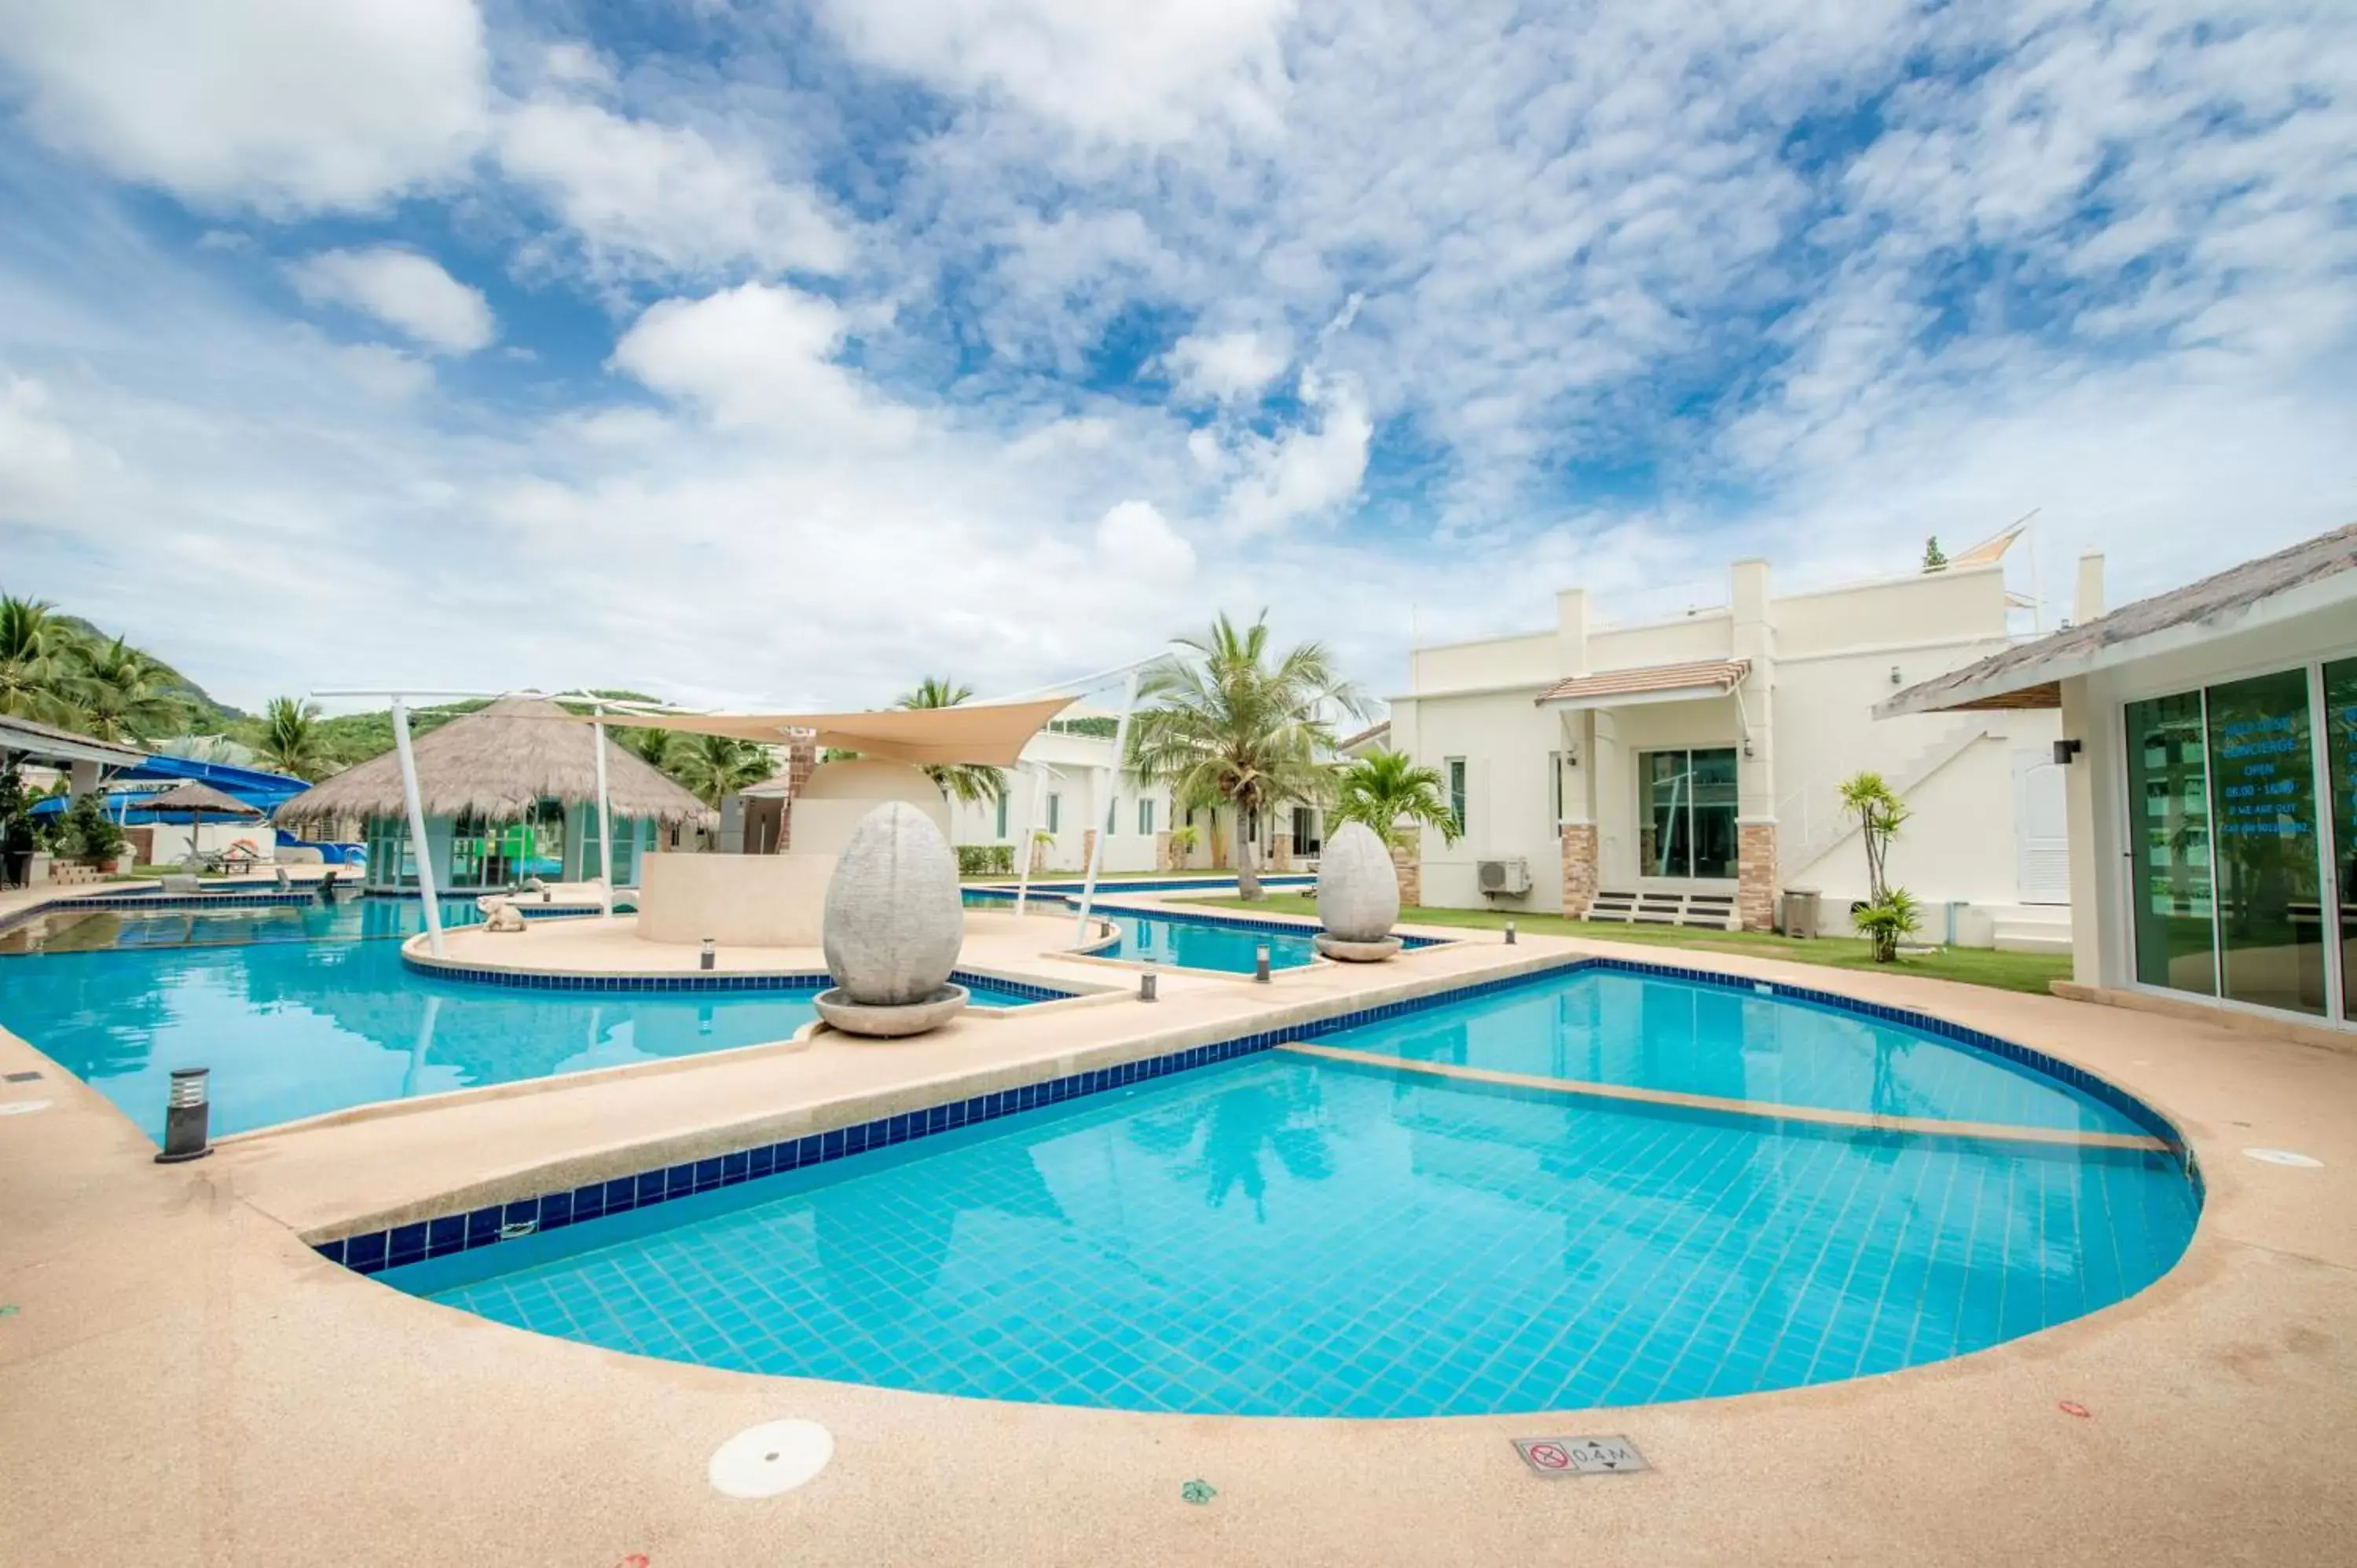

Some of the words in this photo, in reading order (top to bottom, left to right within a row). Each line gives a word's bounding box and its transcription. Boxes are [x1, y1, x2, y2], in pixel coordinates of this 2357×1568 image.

[2223, 738, 2297, 759] CONCIERGE
[2244, 764, 2275, 776] OPEN
[2276, 803, 2297, 814] OUT
